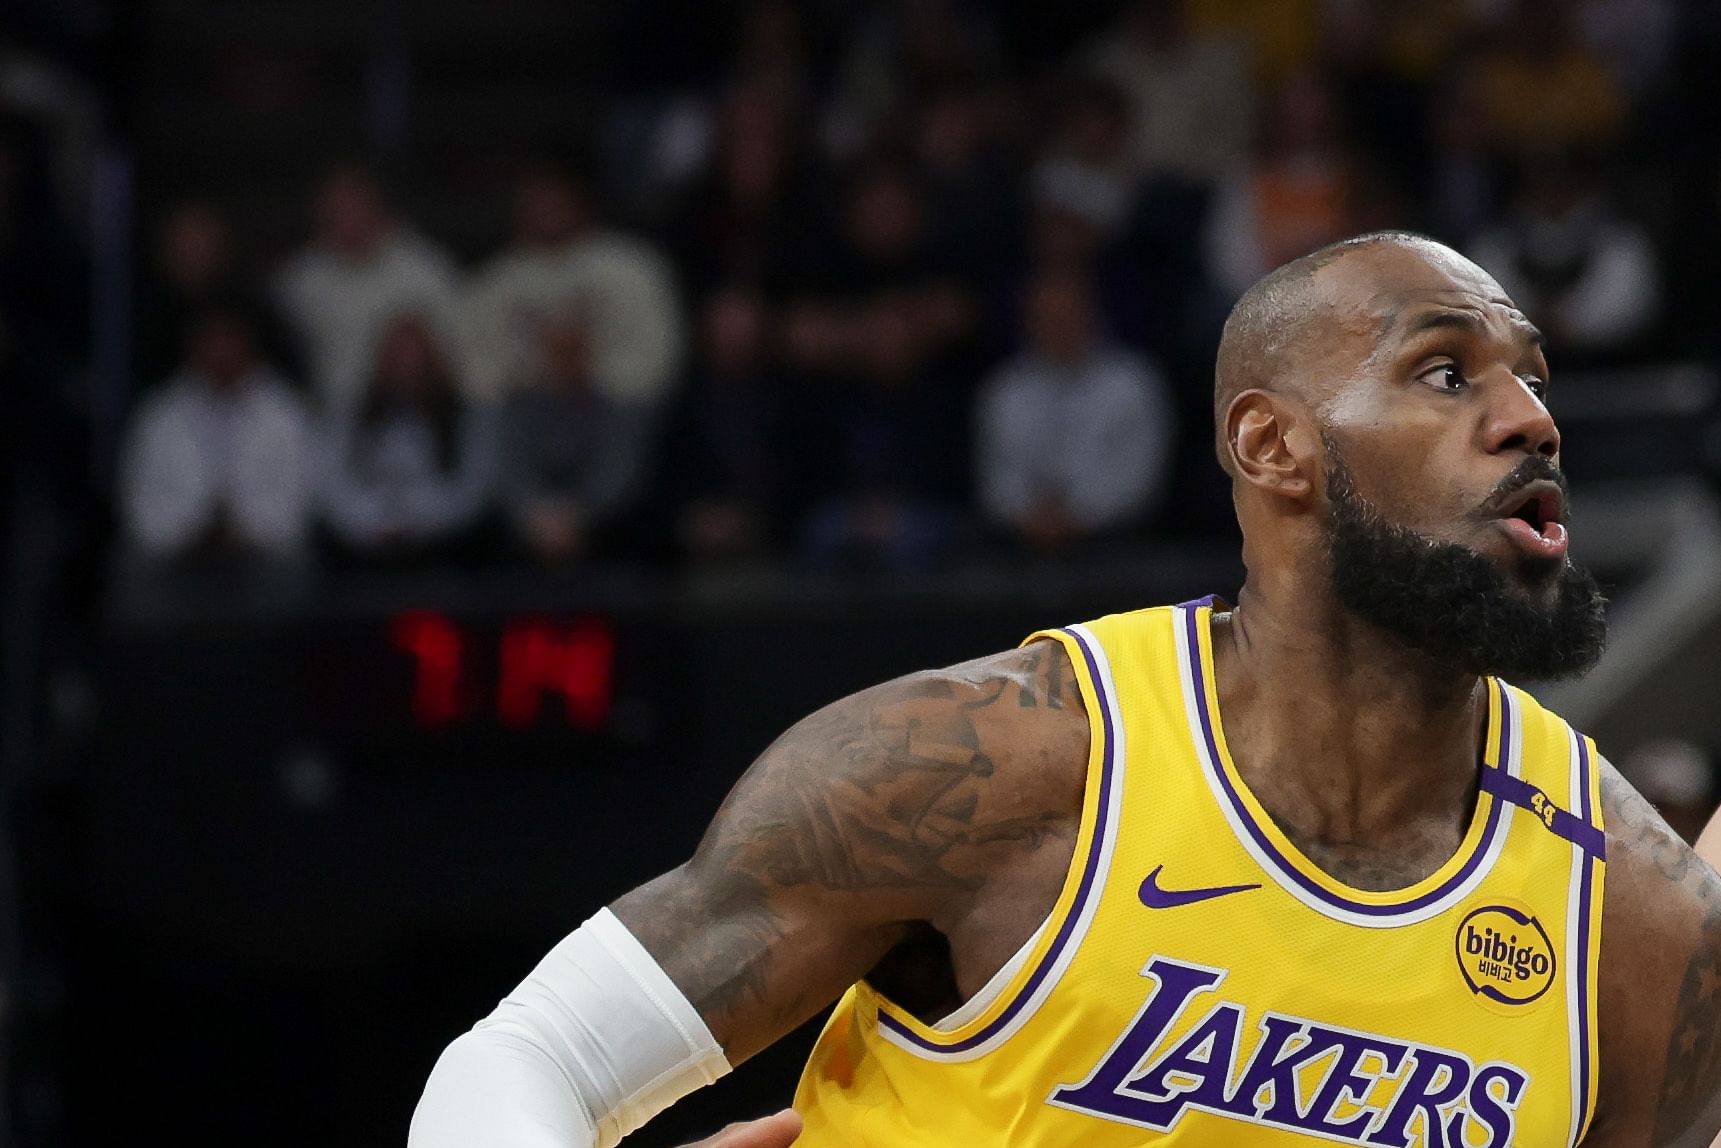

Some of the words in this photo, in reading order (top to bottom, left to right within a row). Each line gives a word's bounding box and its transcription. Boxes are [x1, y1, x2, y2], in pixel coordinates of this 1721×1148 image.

[1530, 792, 1556, 827] 44
[1466, 926, 1549, 981] bibigo
[1478, 959, 1512, 984] 비비고
